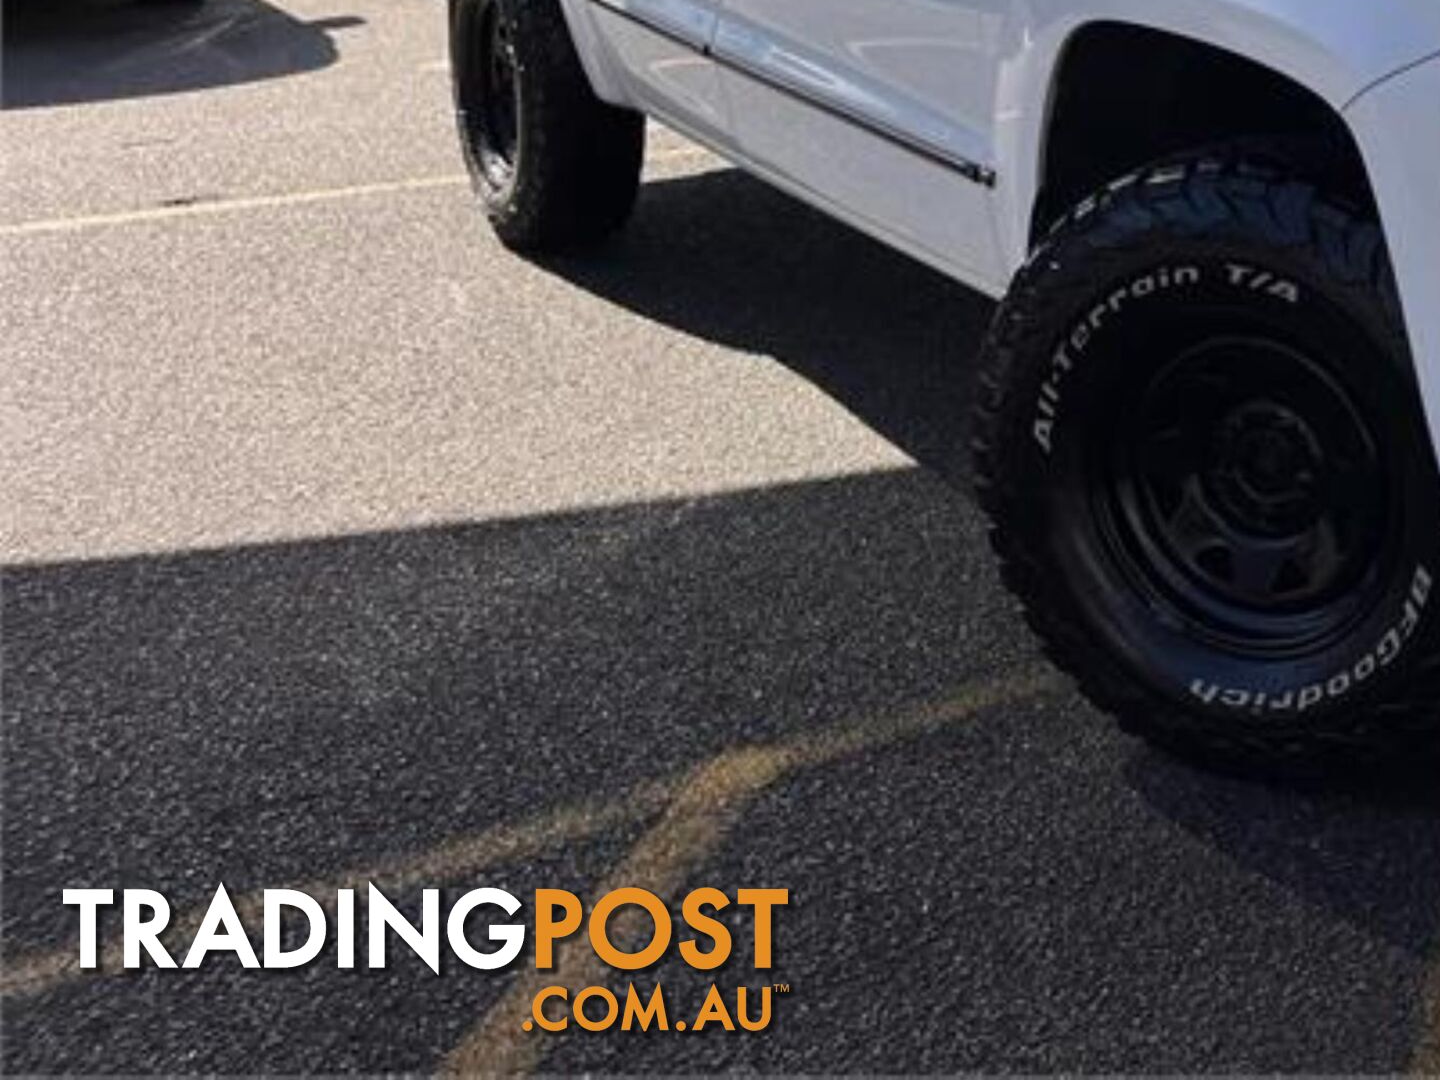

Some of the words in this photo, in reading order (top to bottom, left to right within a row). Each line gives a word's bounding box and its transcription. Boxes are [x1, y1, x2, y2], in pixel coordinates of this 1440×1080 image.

[1031, 264, 1200, 456] All-Terrain
[1223, 262, 1302, 306] T/A
[1187, 562, 1434, 714] BFGoodrich
